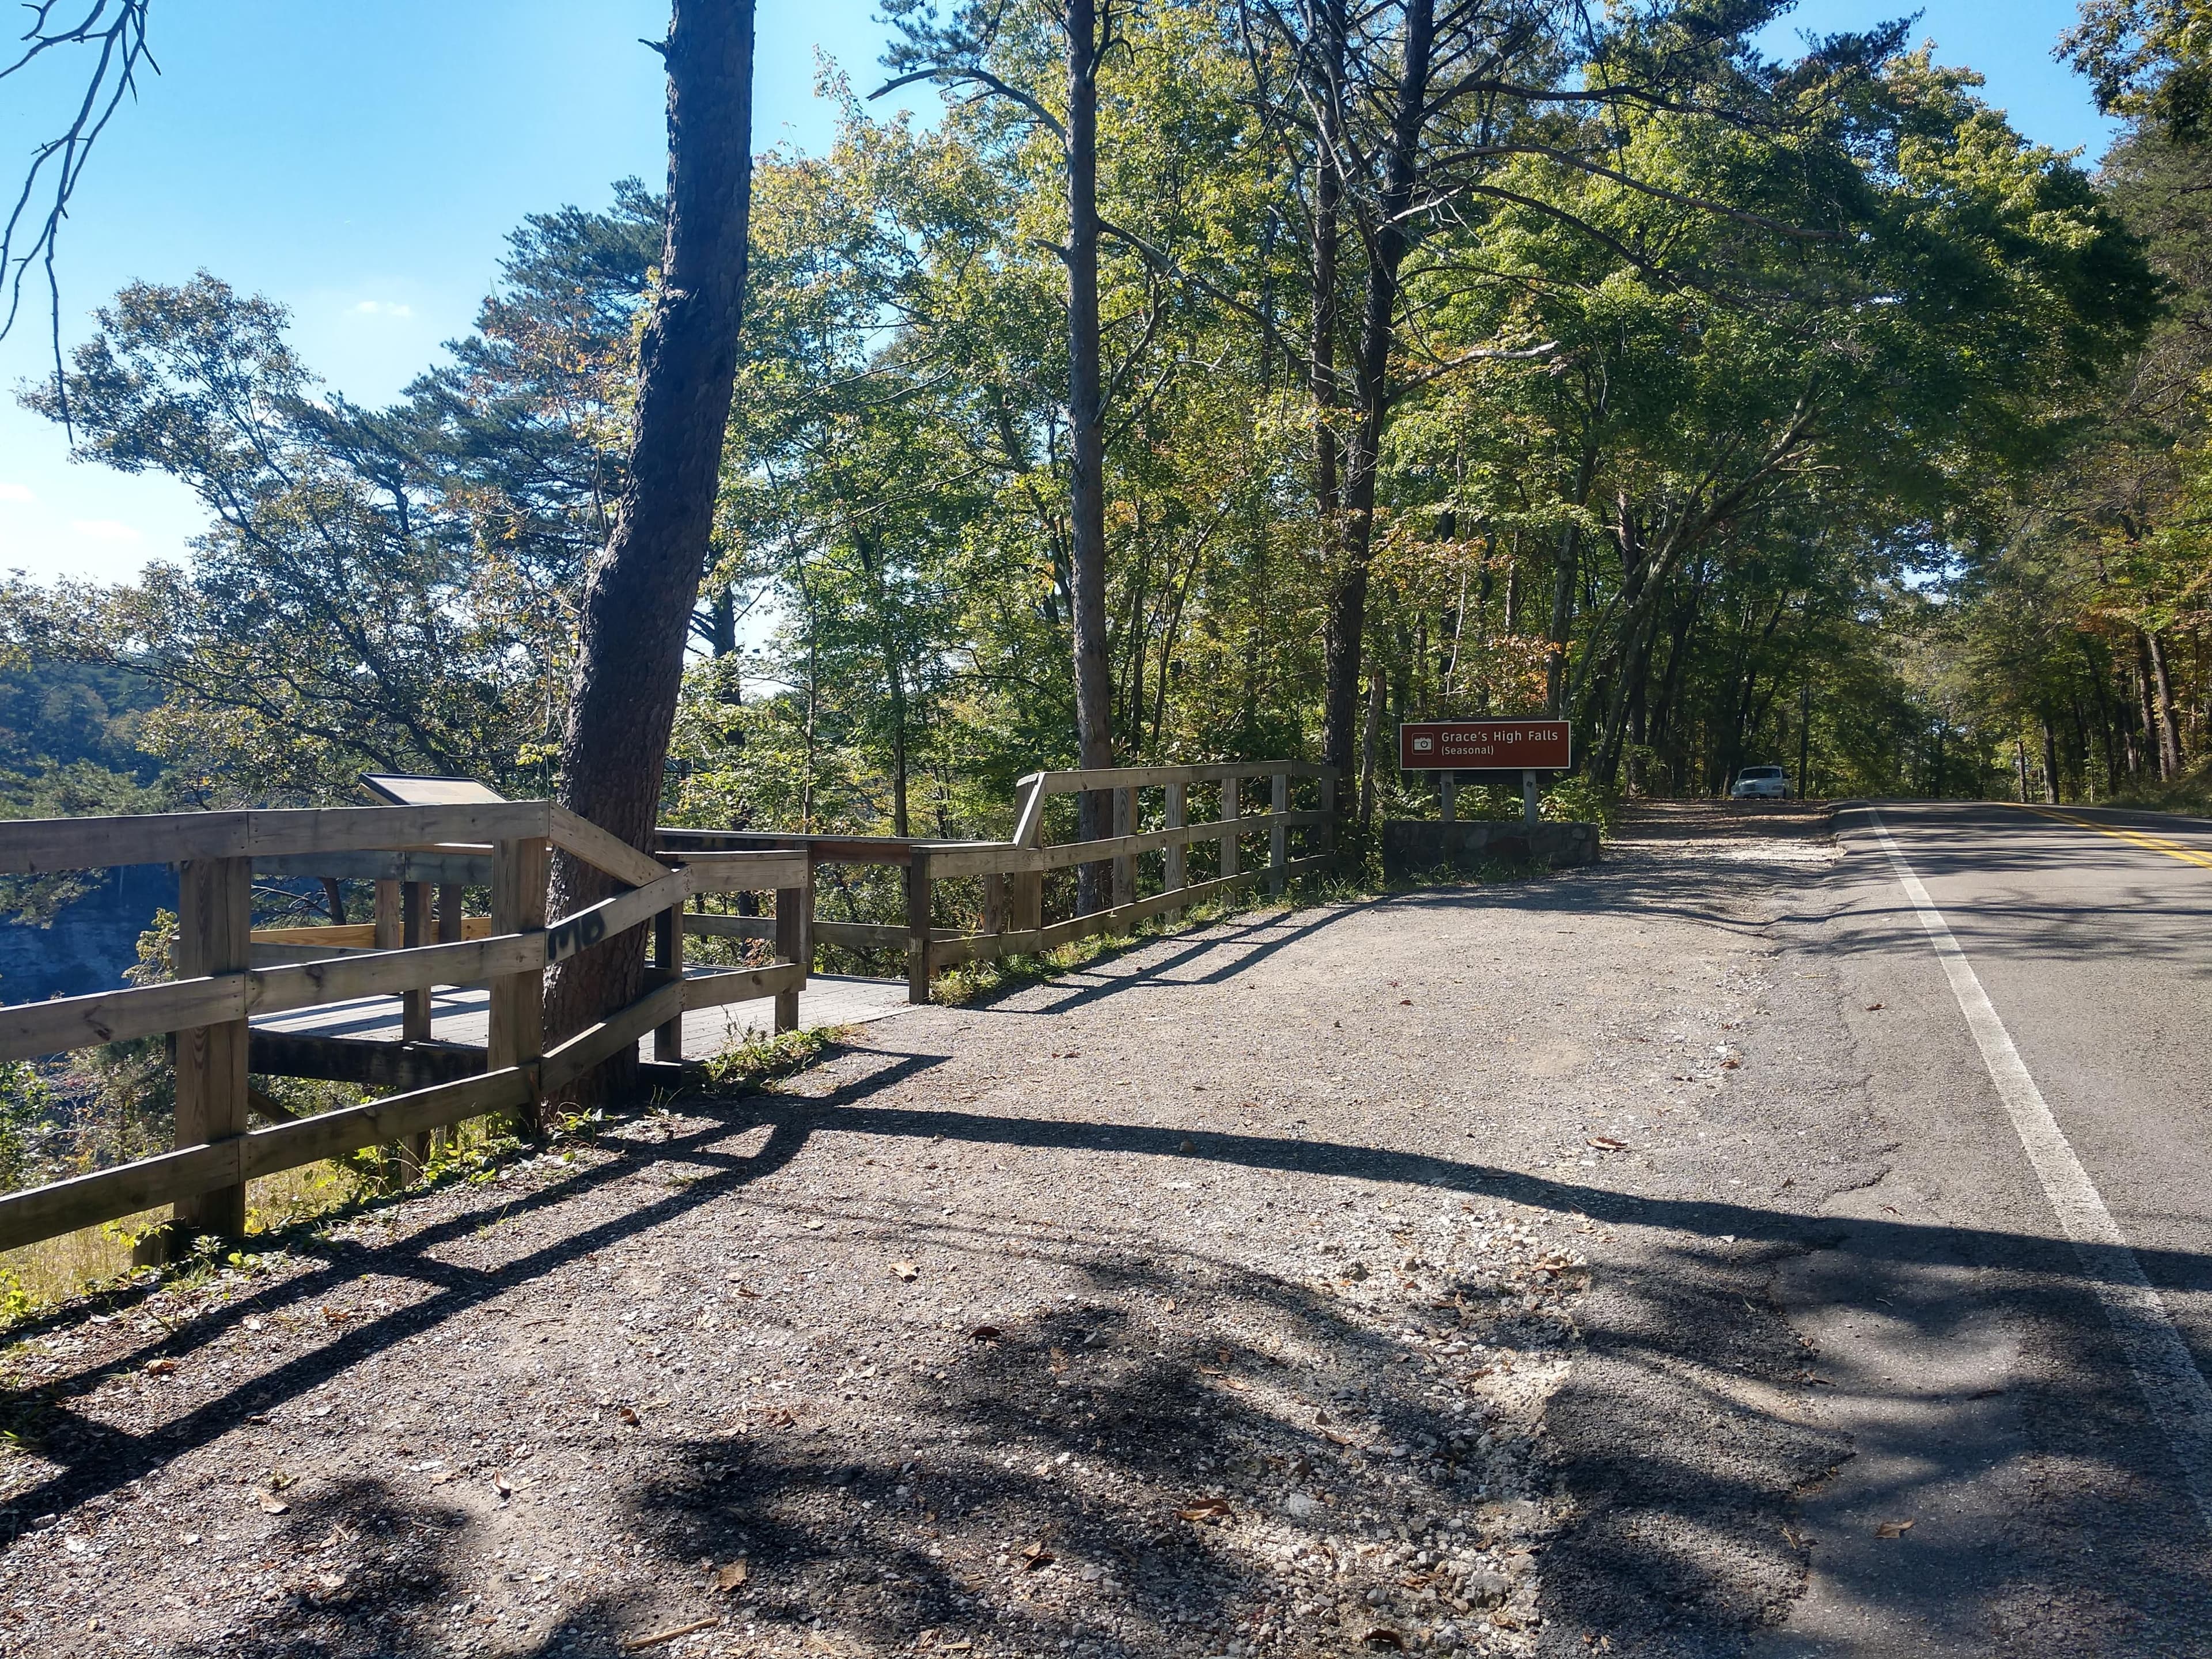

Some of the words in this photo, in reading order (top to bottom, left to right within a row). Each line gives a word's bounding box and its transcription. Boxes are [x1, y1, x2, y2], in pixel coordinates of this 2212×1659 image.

[1441, 731, 1487, 742] Grace's
[1494, 730, 1521, 743] High
[1528, 730, 1558, 741] Falls
[1441, 745, 1493, 756] (Seasonal)
